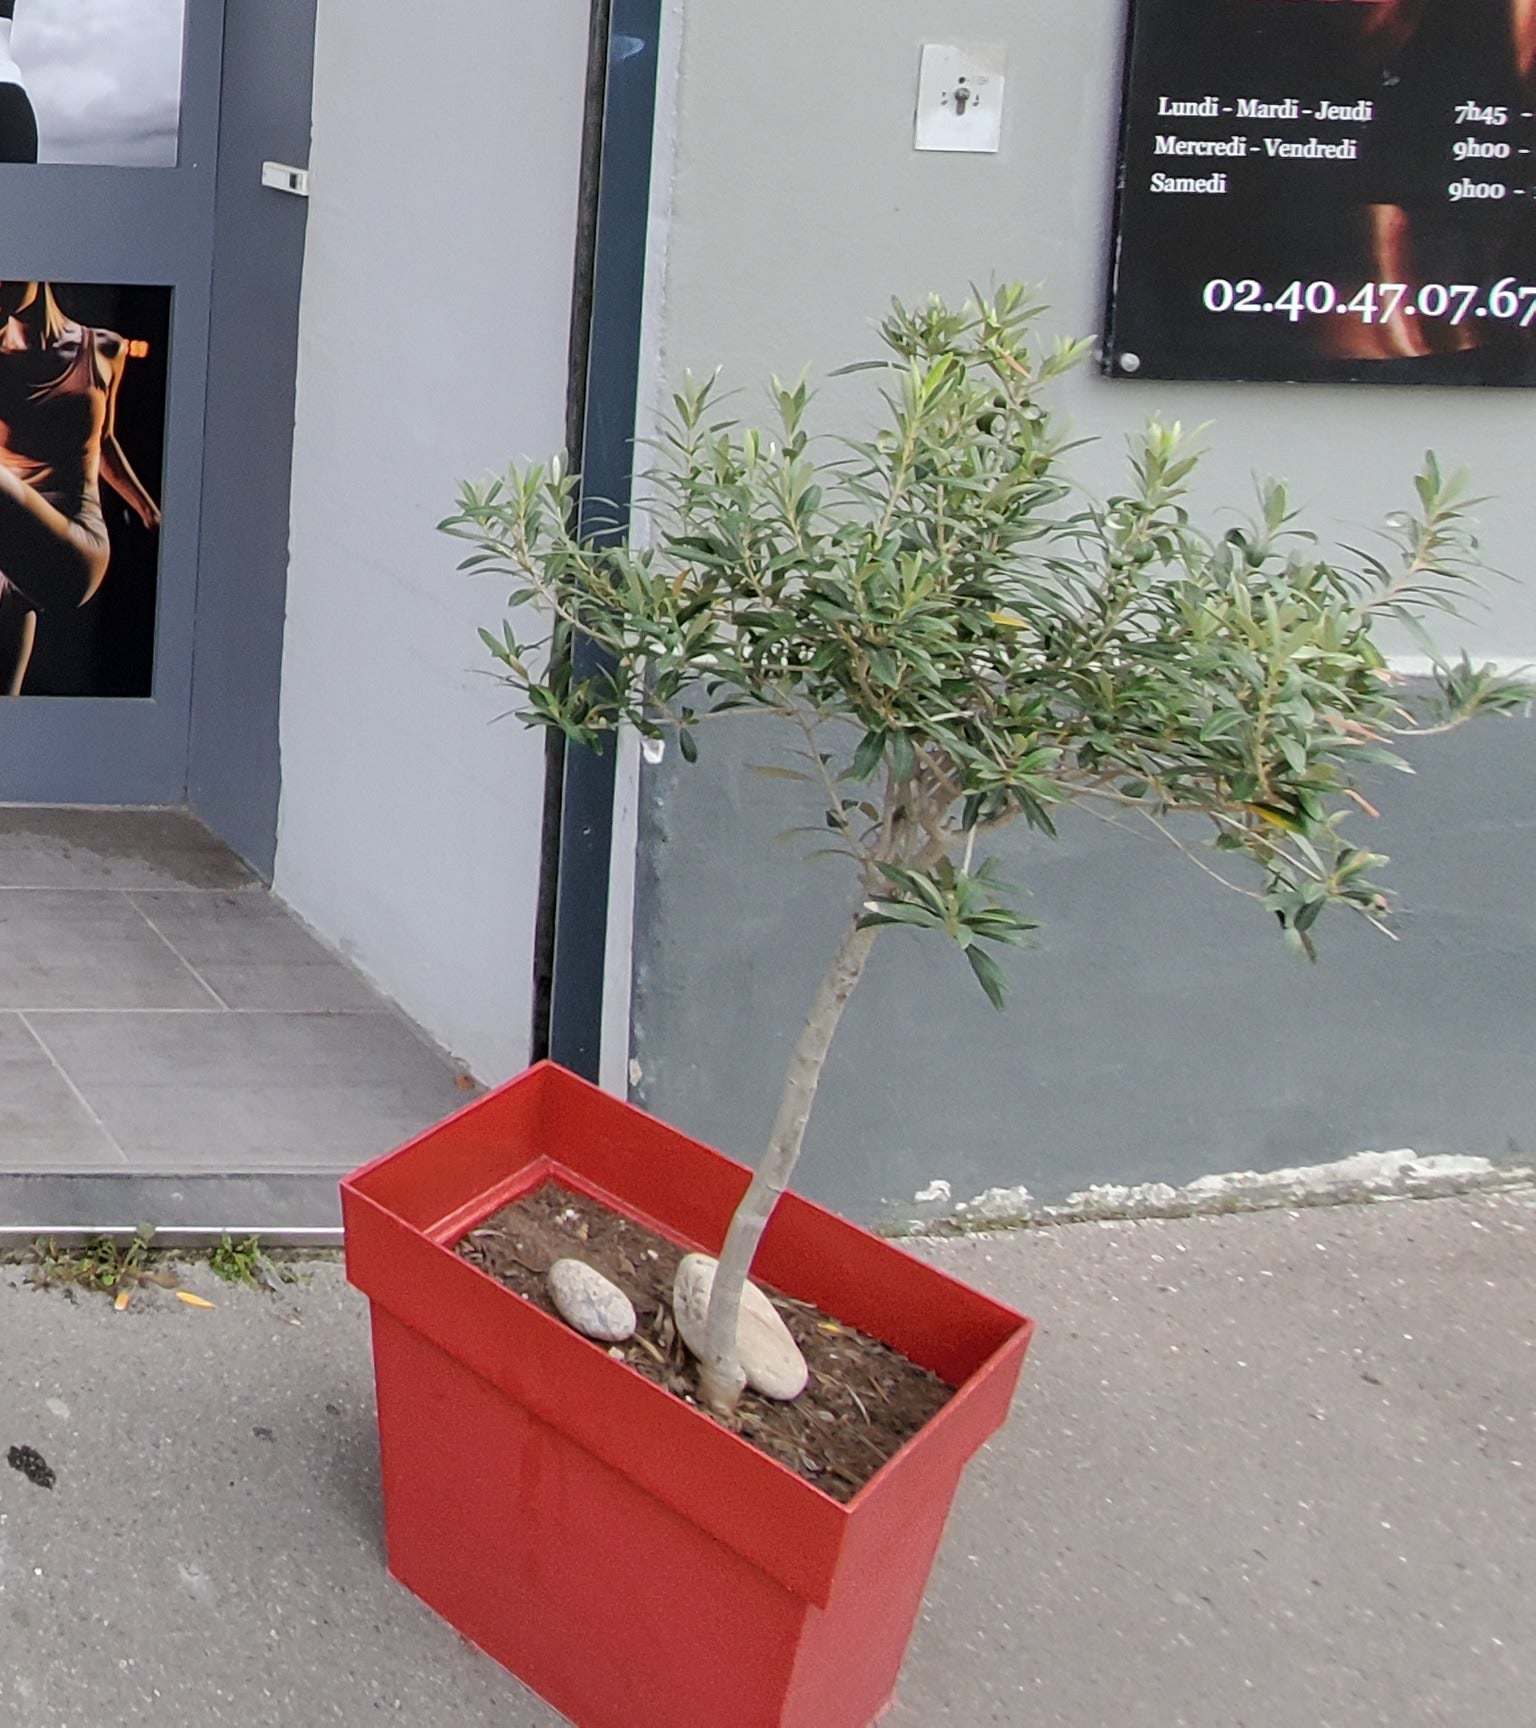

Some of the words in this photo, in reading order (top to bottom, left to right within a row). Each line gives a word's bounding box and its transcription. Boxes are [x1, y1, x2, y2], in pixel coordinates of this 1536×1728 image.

[1157, 97, 1219, 118] Lundi
[1236, 98, 1299, 119] Mardi
[1315, 100, 1373, 121] Jeudi
[1454, 100, 1508, 125] 7h45
[1154, 136, 1247, 157] Mercredi
[1263, 138, 1357, 159] Vendredi
[1452, 137, 1510, 161] 9h00
[1150, 172, 1227, 193] Samedi
[1448, 177, 1505, 201] 9h00
